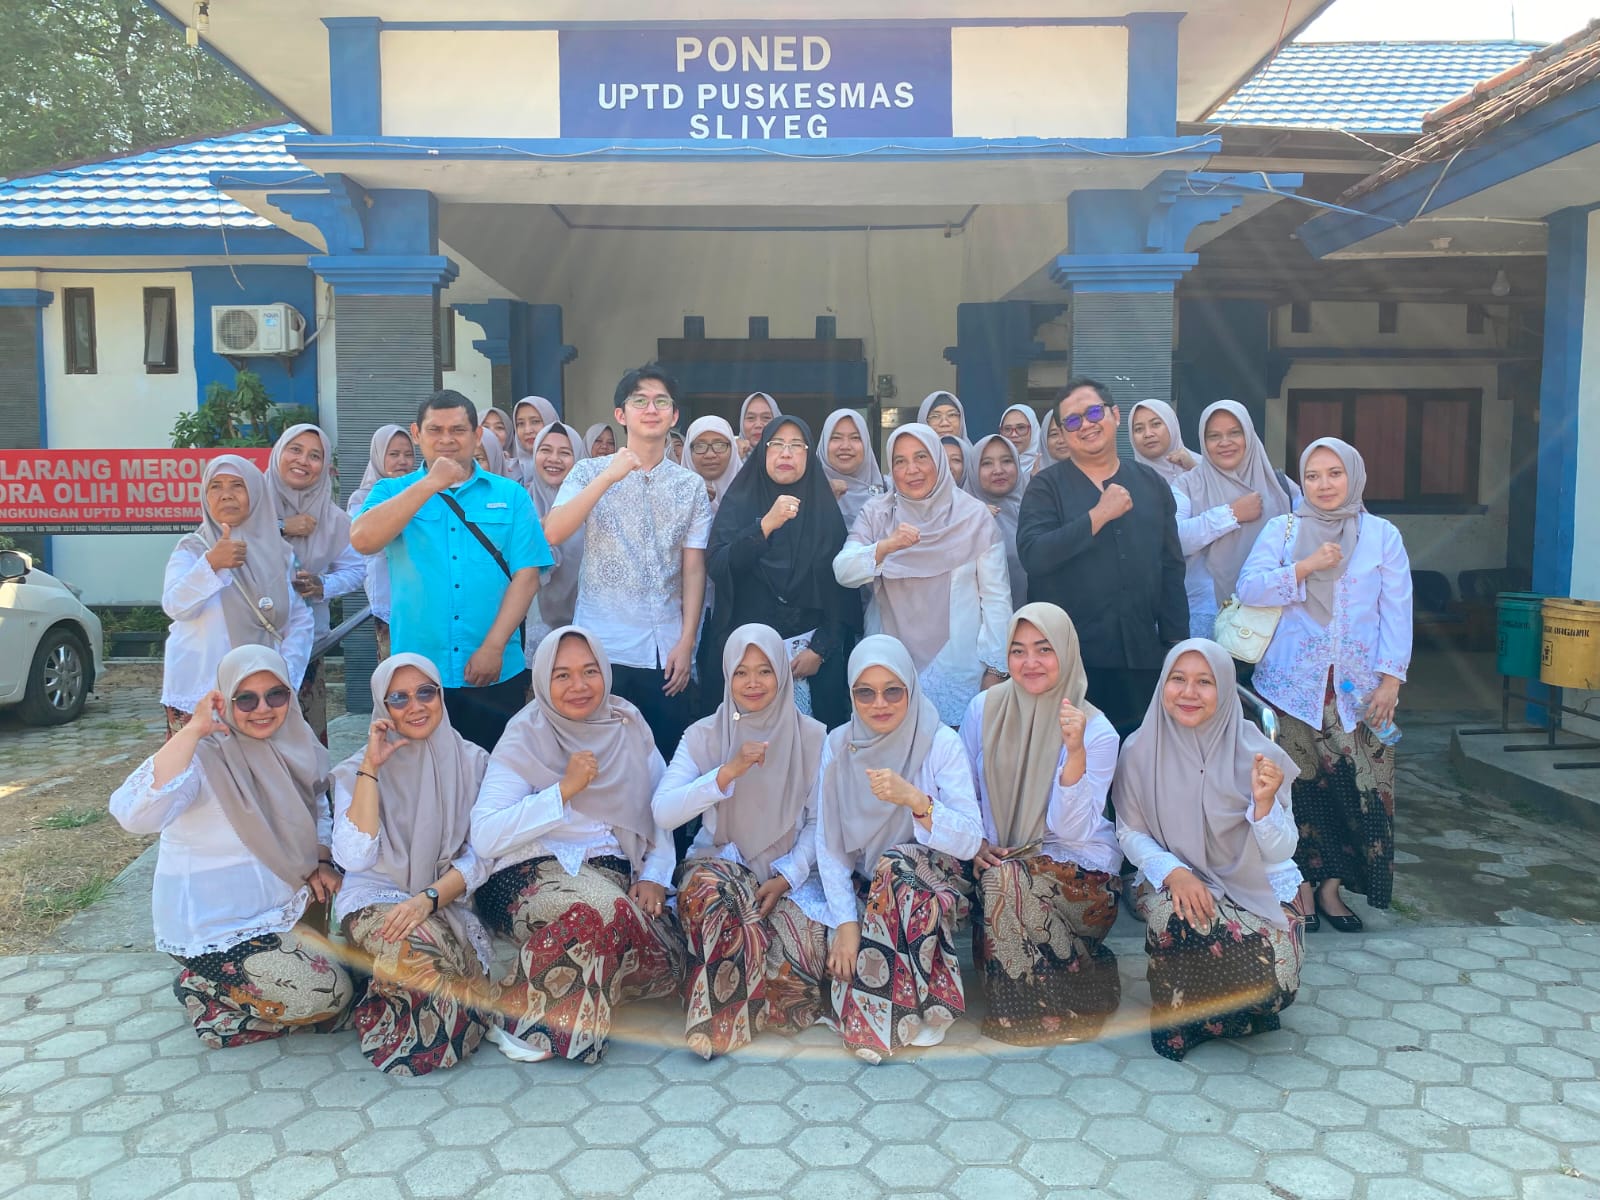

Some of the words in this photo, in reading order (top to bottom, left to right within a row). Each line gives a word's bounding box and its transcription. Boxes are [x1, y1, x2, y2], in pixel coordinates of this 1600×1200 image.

[676, 35, 832, 73] PONED
[598, 83, 684, 110] UPTD
[697, 82, 914, 110] PUSKESMAS
[689, 113, 828, 138] SLIYEG
[120, 458, 257, 480] MEROK
[53, 483, 118, 504] OLIH
[127, 482, 203, 503] NGUD
[83, 508, 121, 518] UPTD
[126, 507, 203, 518] PUSKESMA
